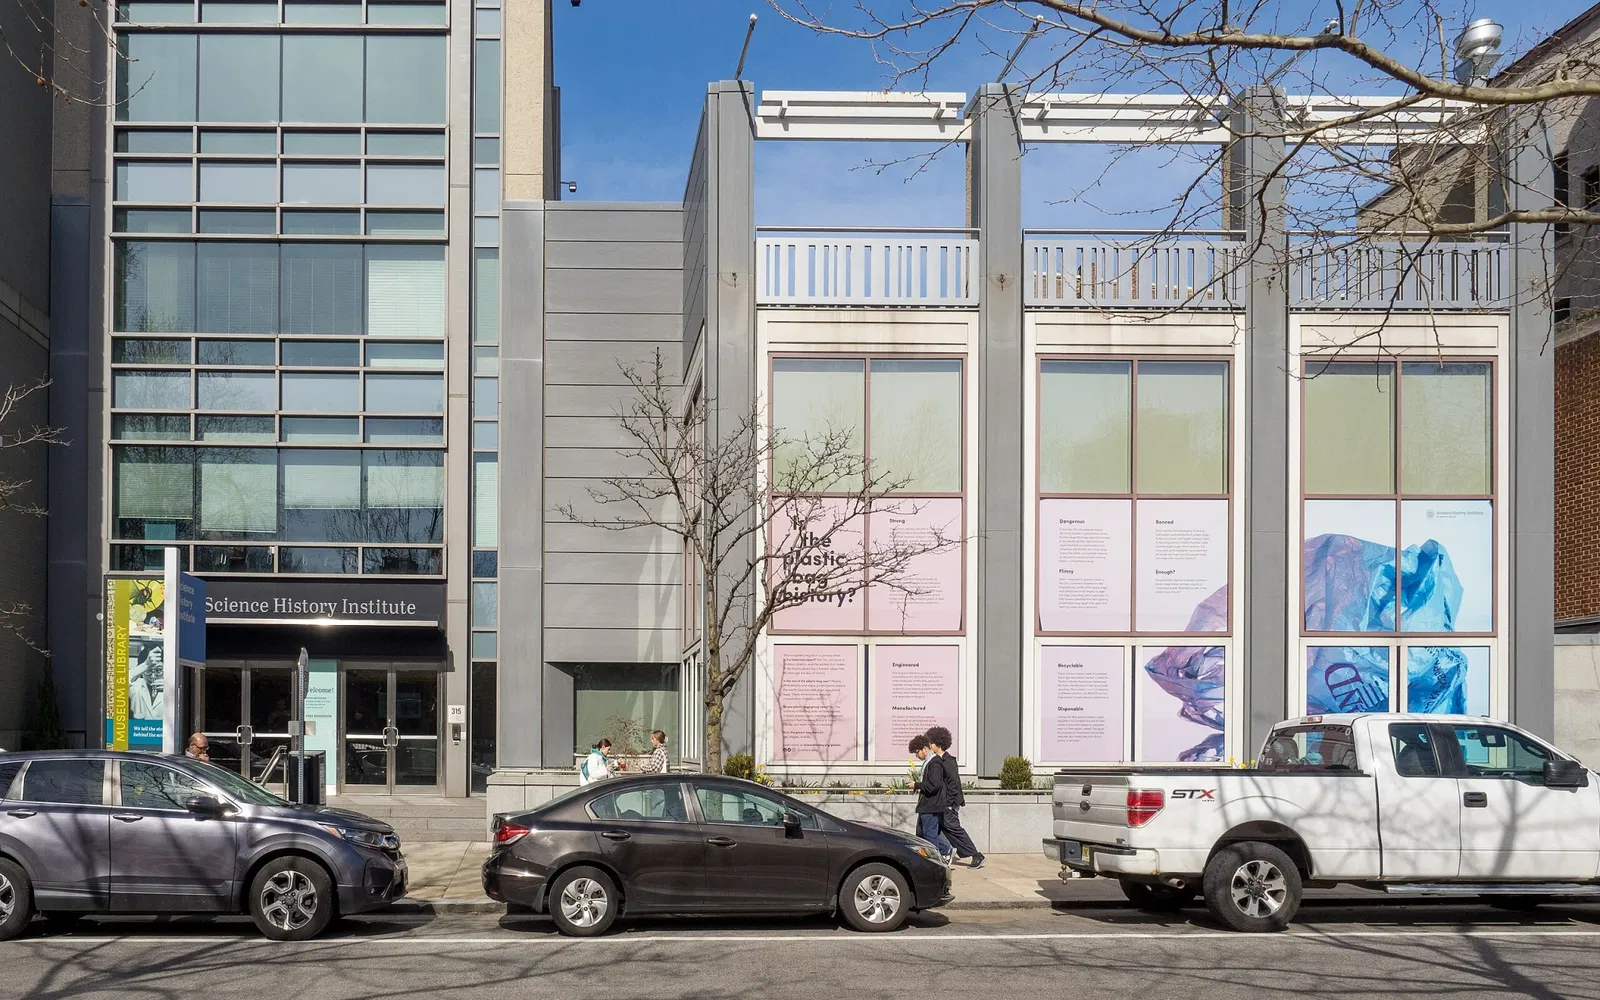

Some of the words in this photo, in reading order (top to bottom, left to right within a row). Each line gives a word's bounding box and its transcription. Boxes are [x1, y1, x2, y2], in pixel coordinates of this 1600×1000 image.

[803, 532, 831, 547] the
[205, 597, 268, 613] Science
[274, 598, 338, 617] History
[342, 598, 416, 615] Institute
[116, 624, 127, 673] LIBRARY
[117, 675, 126, 686] &
[116, 689, 126, 742] MUSEUM
[451, 707, 462, 715] 315
[1171, 789, 1217, 800] STX
